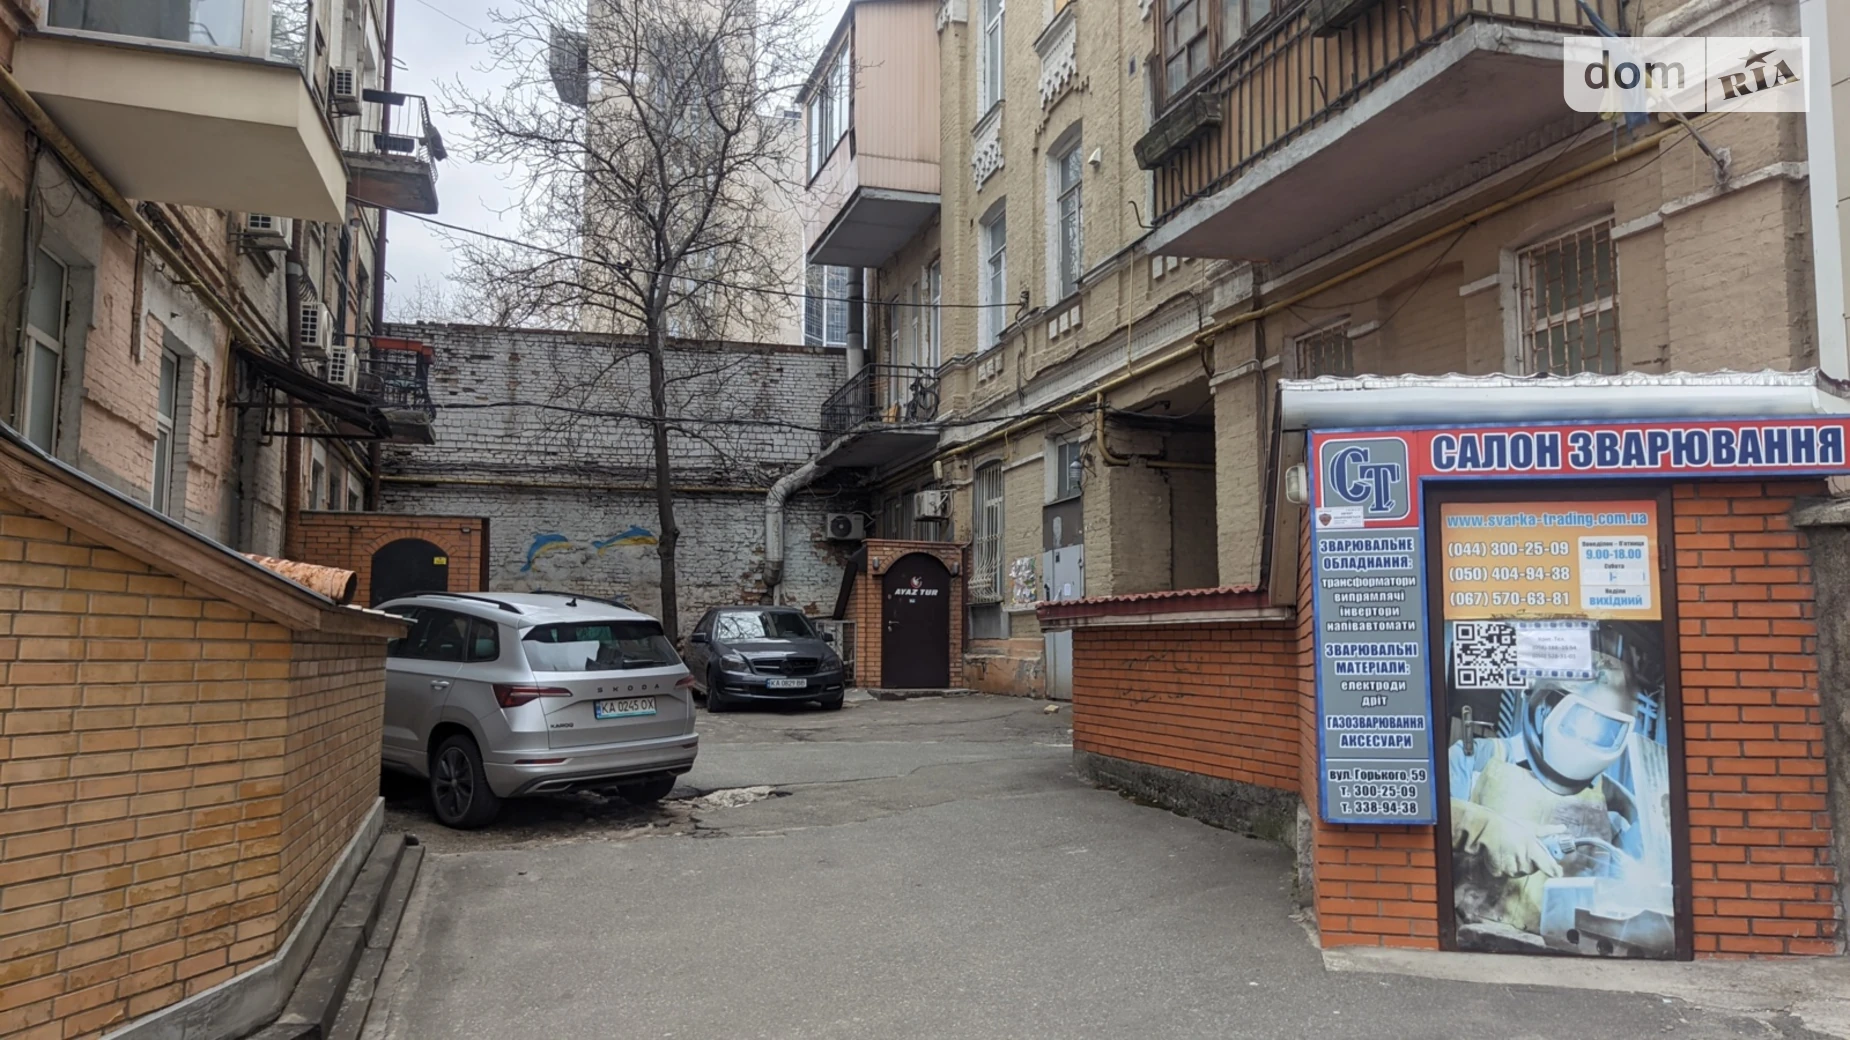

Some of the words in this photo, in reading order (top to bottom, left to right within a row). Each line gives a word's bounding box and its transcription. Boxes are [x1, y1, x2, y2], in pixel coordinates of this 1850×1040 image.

[1431, 431, 1561, 471] САЛОН
[1568, 425, 1846, 470] ЗВАРЮВАННЯ
[1446, 511, 1648, 528] www.svarka-trading.com.ua
[1319, 537, 1415, 553] ЗВАРЮВАЛЬНЕ
[1448, 542, 1487, 557] (044)
[1490, 541, 1569, 556] 300-25-09
[1586, 548, 1642, 560] 9.00-18.00
[1322, 555, 1414, 572] ОБЛАДНАННЯ:
[1449, 567, 1488, 582] (050)
[1491, 566, 1571, 581] 404-94-38
[1322, 577, 1417, 589] трансформатори
[894, 588, 918, 596] AYAZ
[919, 588, 939, 596] TUR
[1334, 591, 1405, 603] випрямлячі
[1450, 593, 1488, 607] (067)
[1492, 592, 1570, 606] 570-63-81
[1589, 595, 1643, 606] вихідний
[1339, 606, 1400, 618] інвертори
[1326, 620, 1416, 632] напівавтомати
[1325, 642, 1418, 657] ЗВАРЮВАЛЬНІ
[1335, 660, 1411, 675] МАТЕРІАЛИ:
[1341, 681, 1406, 692] електроди
[602, 702, 616, 713] KA
[618, 700, 638, 712] 0245
[641, 699, 654, 710] OX
[1362, 694, 1387, 707] дріт
[1326, 714, 1425, 730] ГАЗОЗВАРЮВАННЯ
[1340, 733, 1413, 748] АКСЕСУАРИ
[1328, 769, 1352, 781] вул.
[1354, 768, 1409, 782] Горького,
[1410, 769, 1427, 782] 59
[1339, 786, 1352, 797] т.
[1354, 785, 1417, 798] 300-25-09
[1340, 802, 1352, 814] т.
[1354, 801, 1418, 815] 338-94-38
